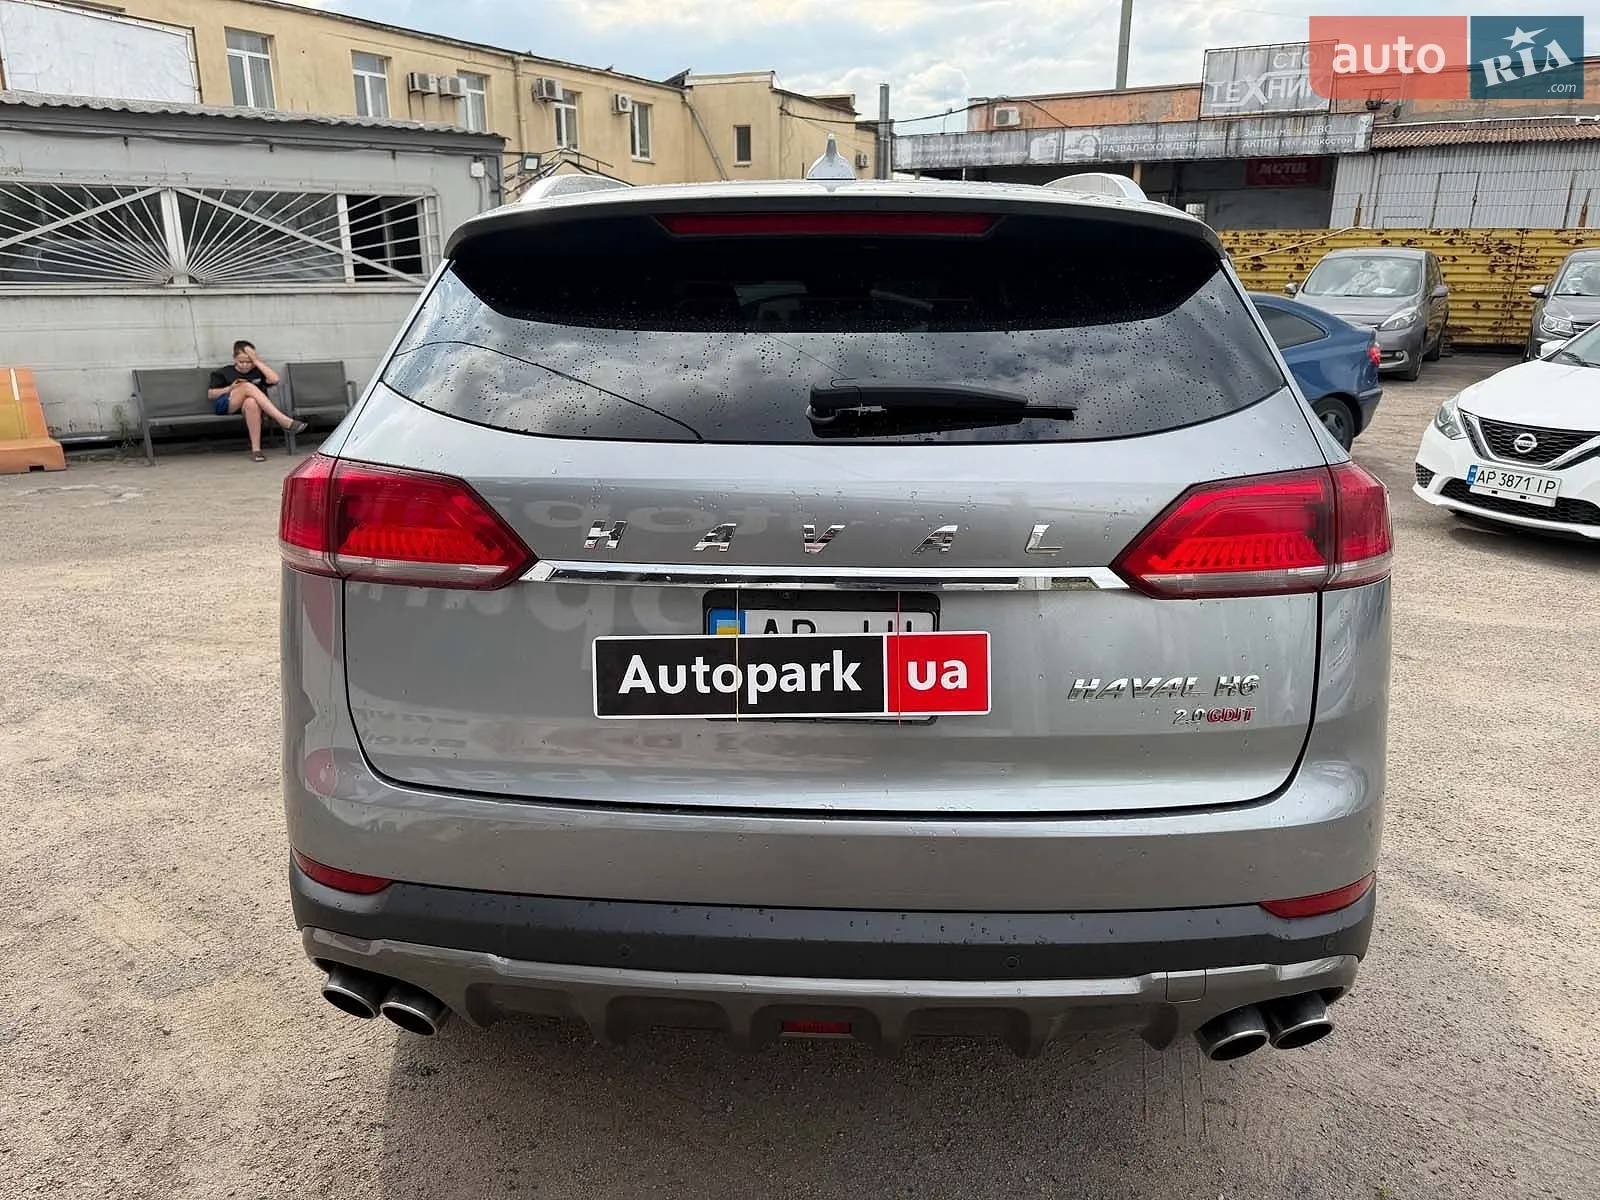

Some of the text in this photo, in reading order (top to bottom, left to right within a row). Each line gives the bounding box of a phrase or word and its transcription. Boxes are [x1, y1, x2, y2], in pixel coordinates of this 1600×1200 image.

[1273, 51, 1318, 70] СТО
[1477, 470, 1556, 494] AP 3871 IP
[618, 650, 968, 705] Autopark ua
[1067, 675, 1260, 700] HAVAL H6
